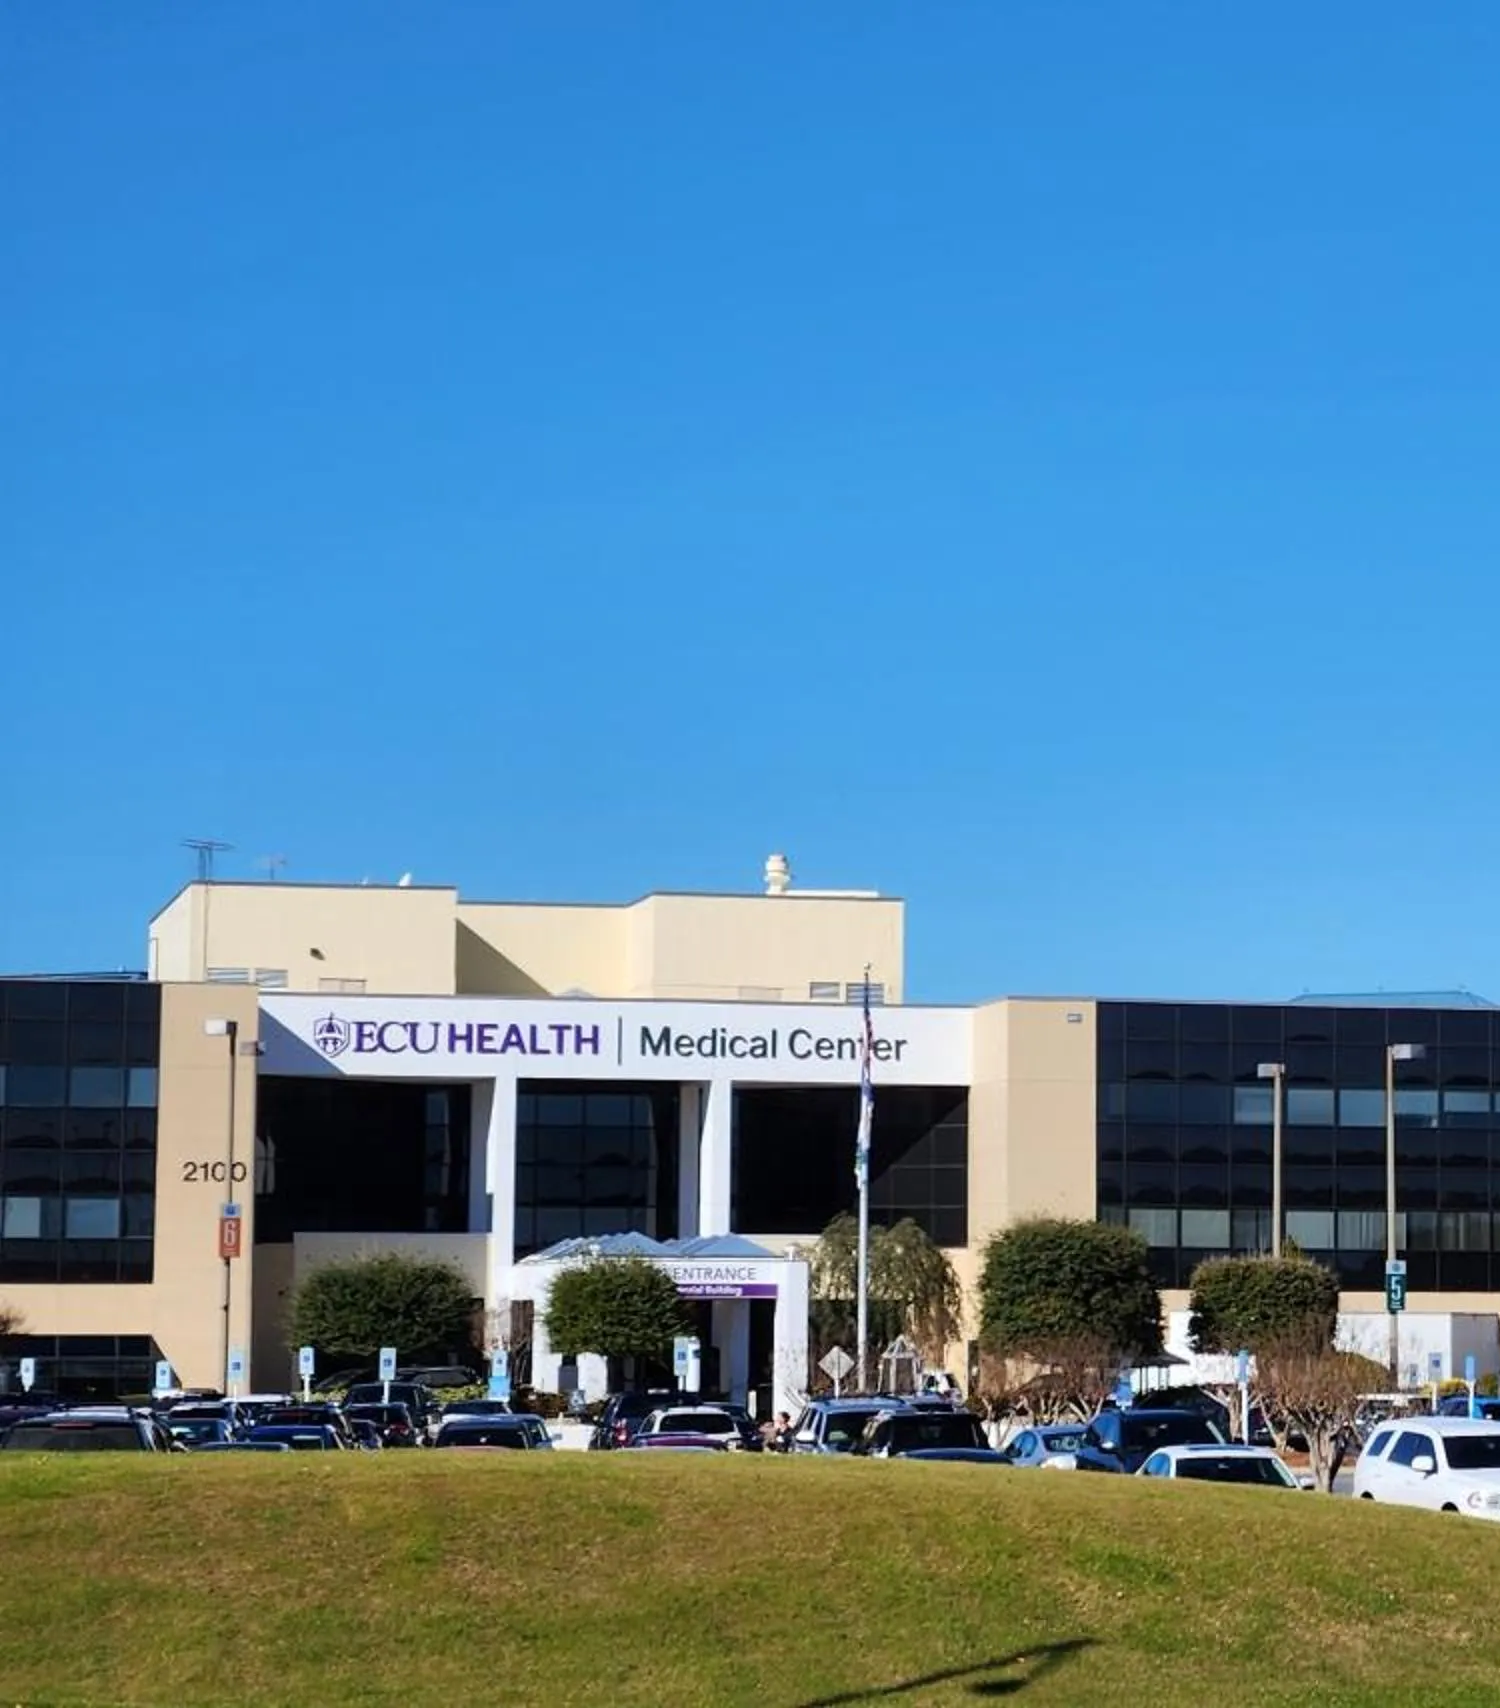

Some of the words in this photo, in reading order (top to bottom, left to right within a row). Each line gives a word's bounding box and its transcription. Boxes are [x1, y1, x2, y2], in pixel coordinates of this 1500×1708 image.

[352, 1021, 440, 1054] ECU
[449, 1023, 600, 1055] HEALTH
[640, 1025, 777, 1059] Medical
[183, 1161, 247, 1183] 2100
[223, 1219, 237, 1246] 6
[673, 1267, 757, 1281] ENTRANCE
[1391, 1275, 1401, 1300] 5
